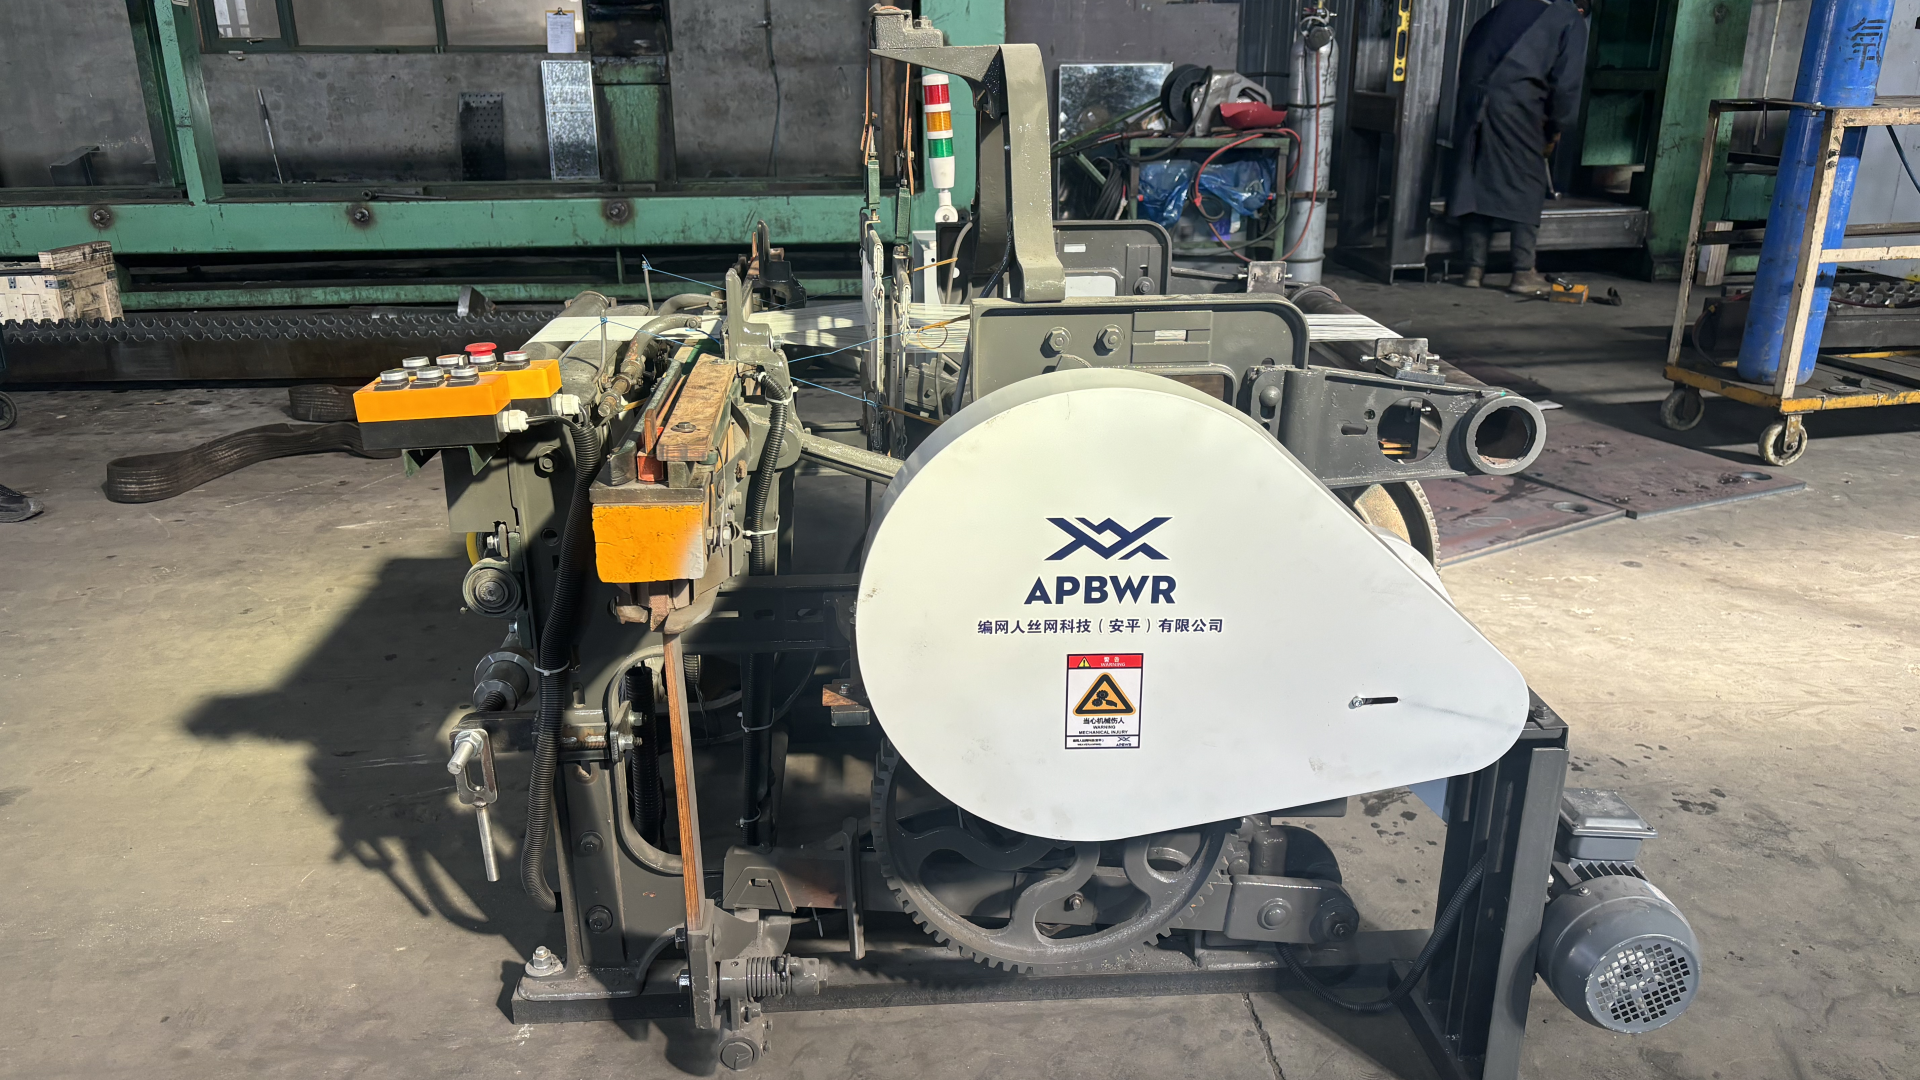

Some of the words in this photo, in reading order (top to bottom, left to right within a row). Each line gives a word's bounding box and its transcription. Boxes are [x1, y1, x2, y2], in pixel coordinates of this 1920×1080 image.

[1024, 575, 1177, 605] APBWR
[977, 618, 1223, 634] 编网人丝网科技（安平）有限公司
[1083, 717, 1125, 725] 当心机械伤人
